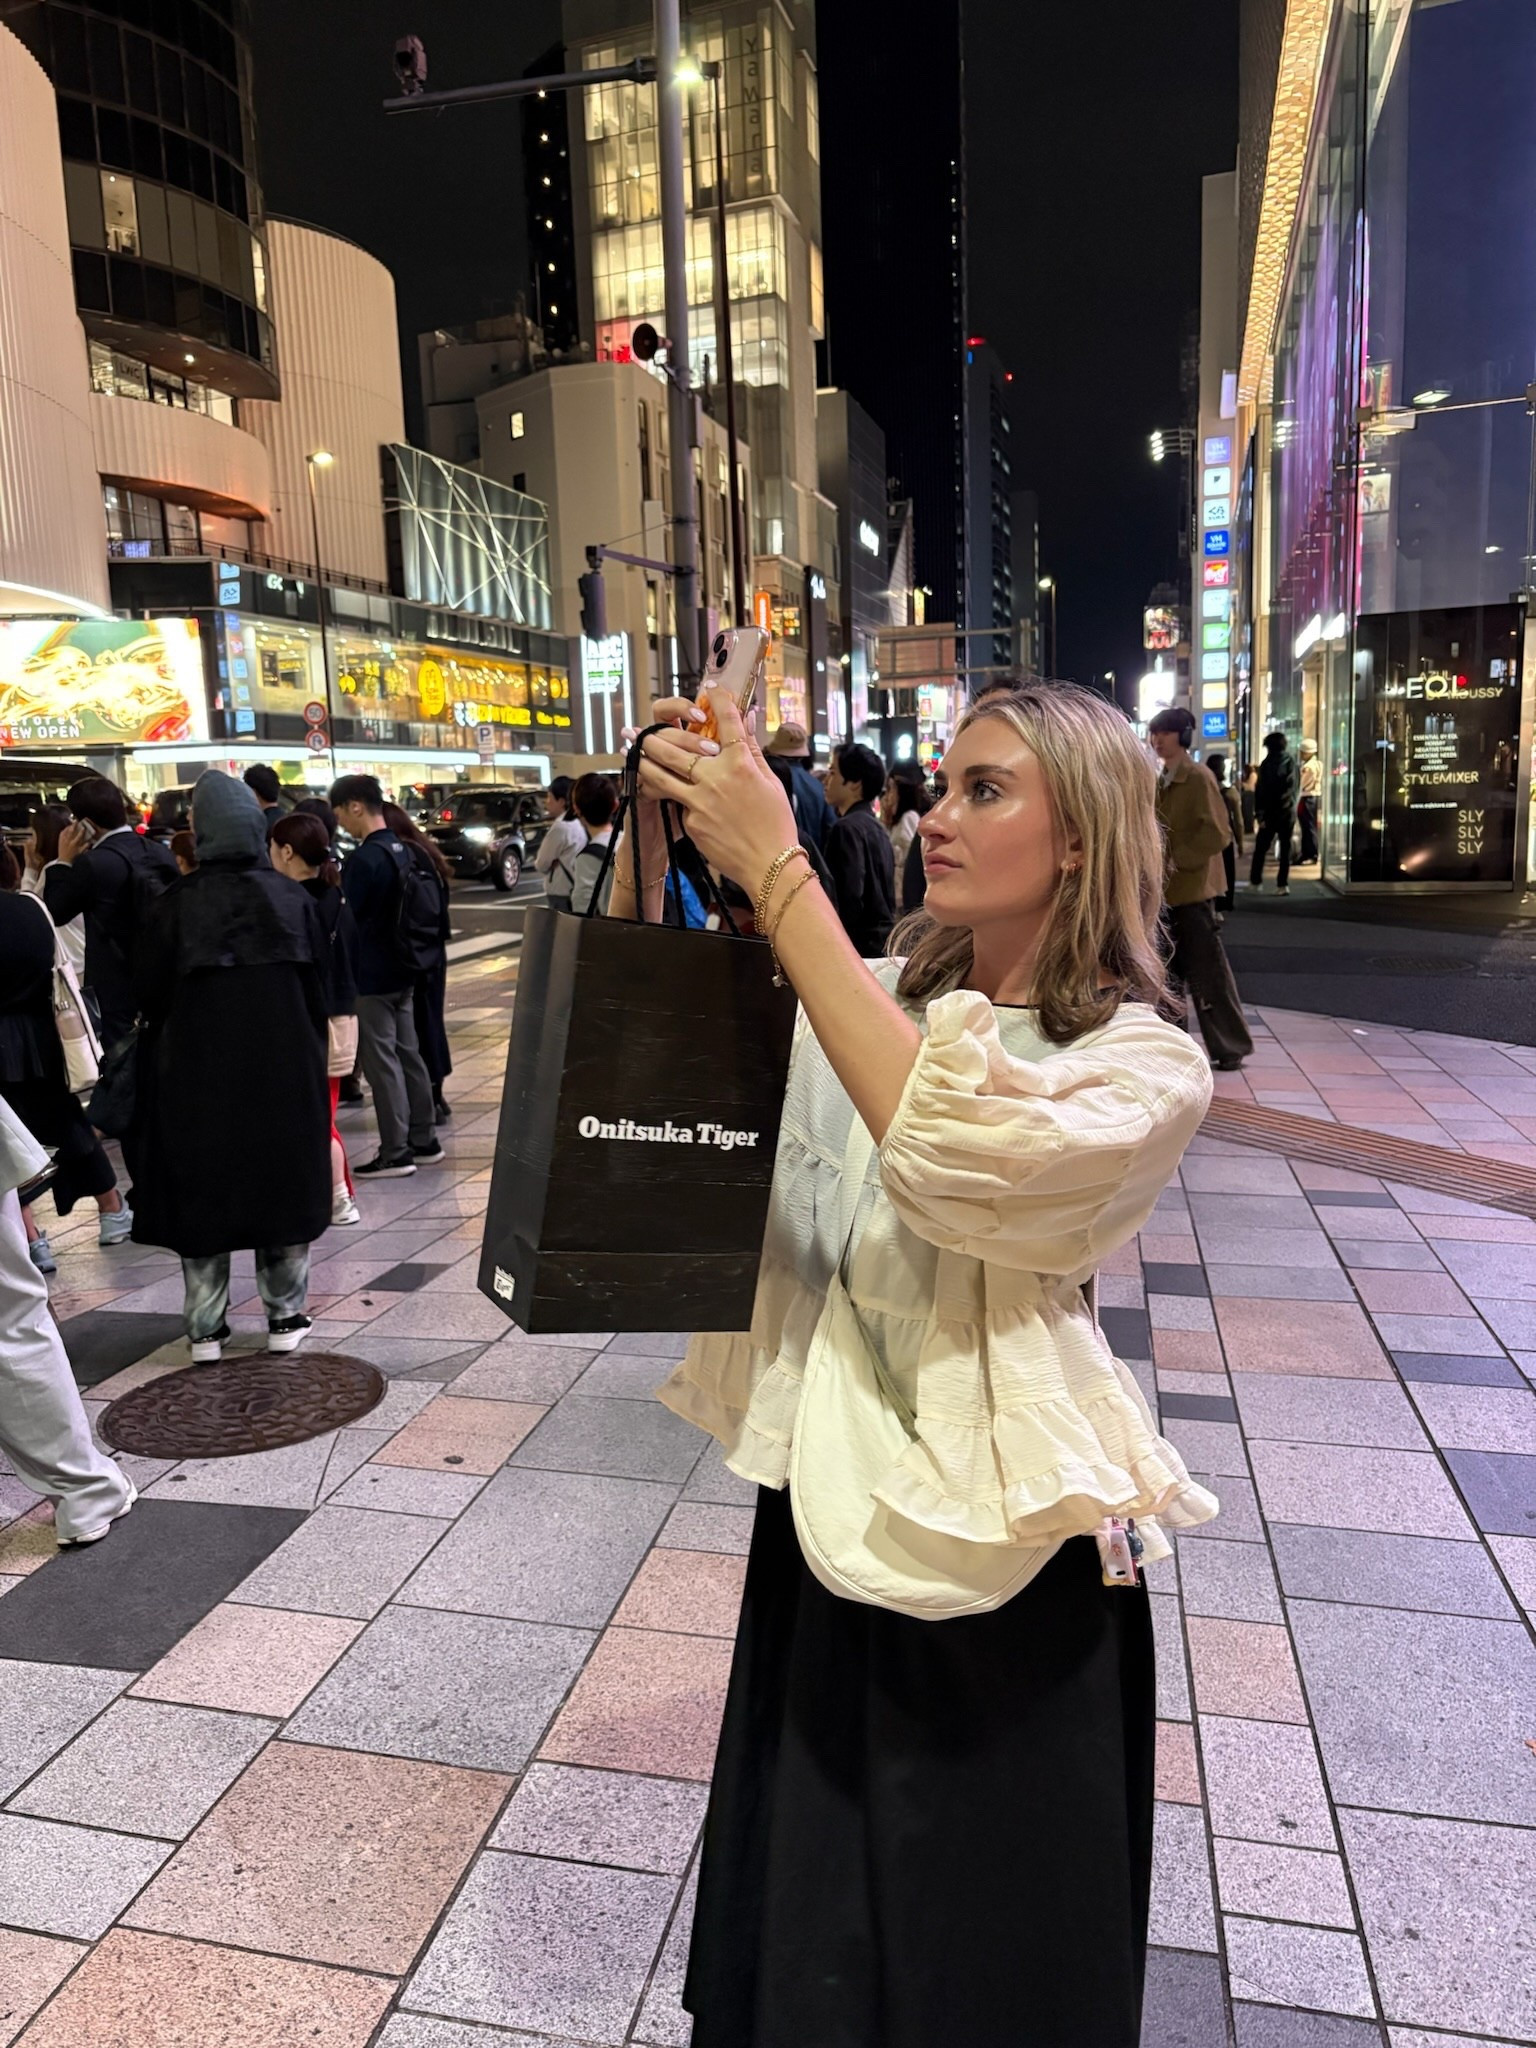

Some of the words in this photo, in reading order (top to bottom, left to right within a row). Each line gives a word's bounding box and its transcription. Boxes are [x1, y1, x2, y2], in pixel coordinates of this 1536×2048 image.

[1407, 675, 1469, 699] EQL
[37, 726, 80, 738] OPEN
[480, 728, 491, 742] P
[1403, 771, 1478, 785] STYLEMIXER
[1458, 810, 1485, 823] SLY
[1458, 826, 1484, 839] SLY
[1457, 841, 1483, 854] SLY
[578, 1116, 693, 1143] Onitsuka
[697, 1123, 759, 1150] Tiger
